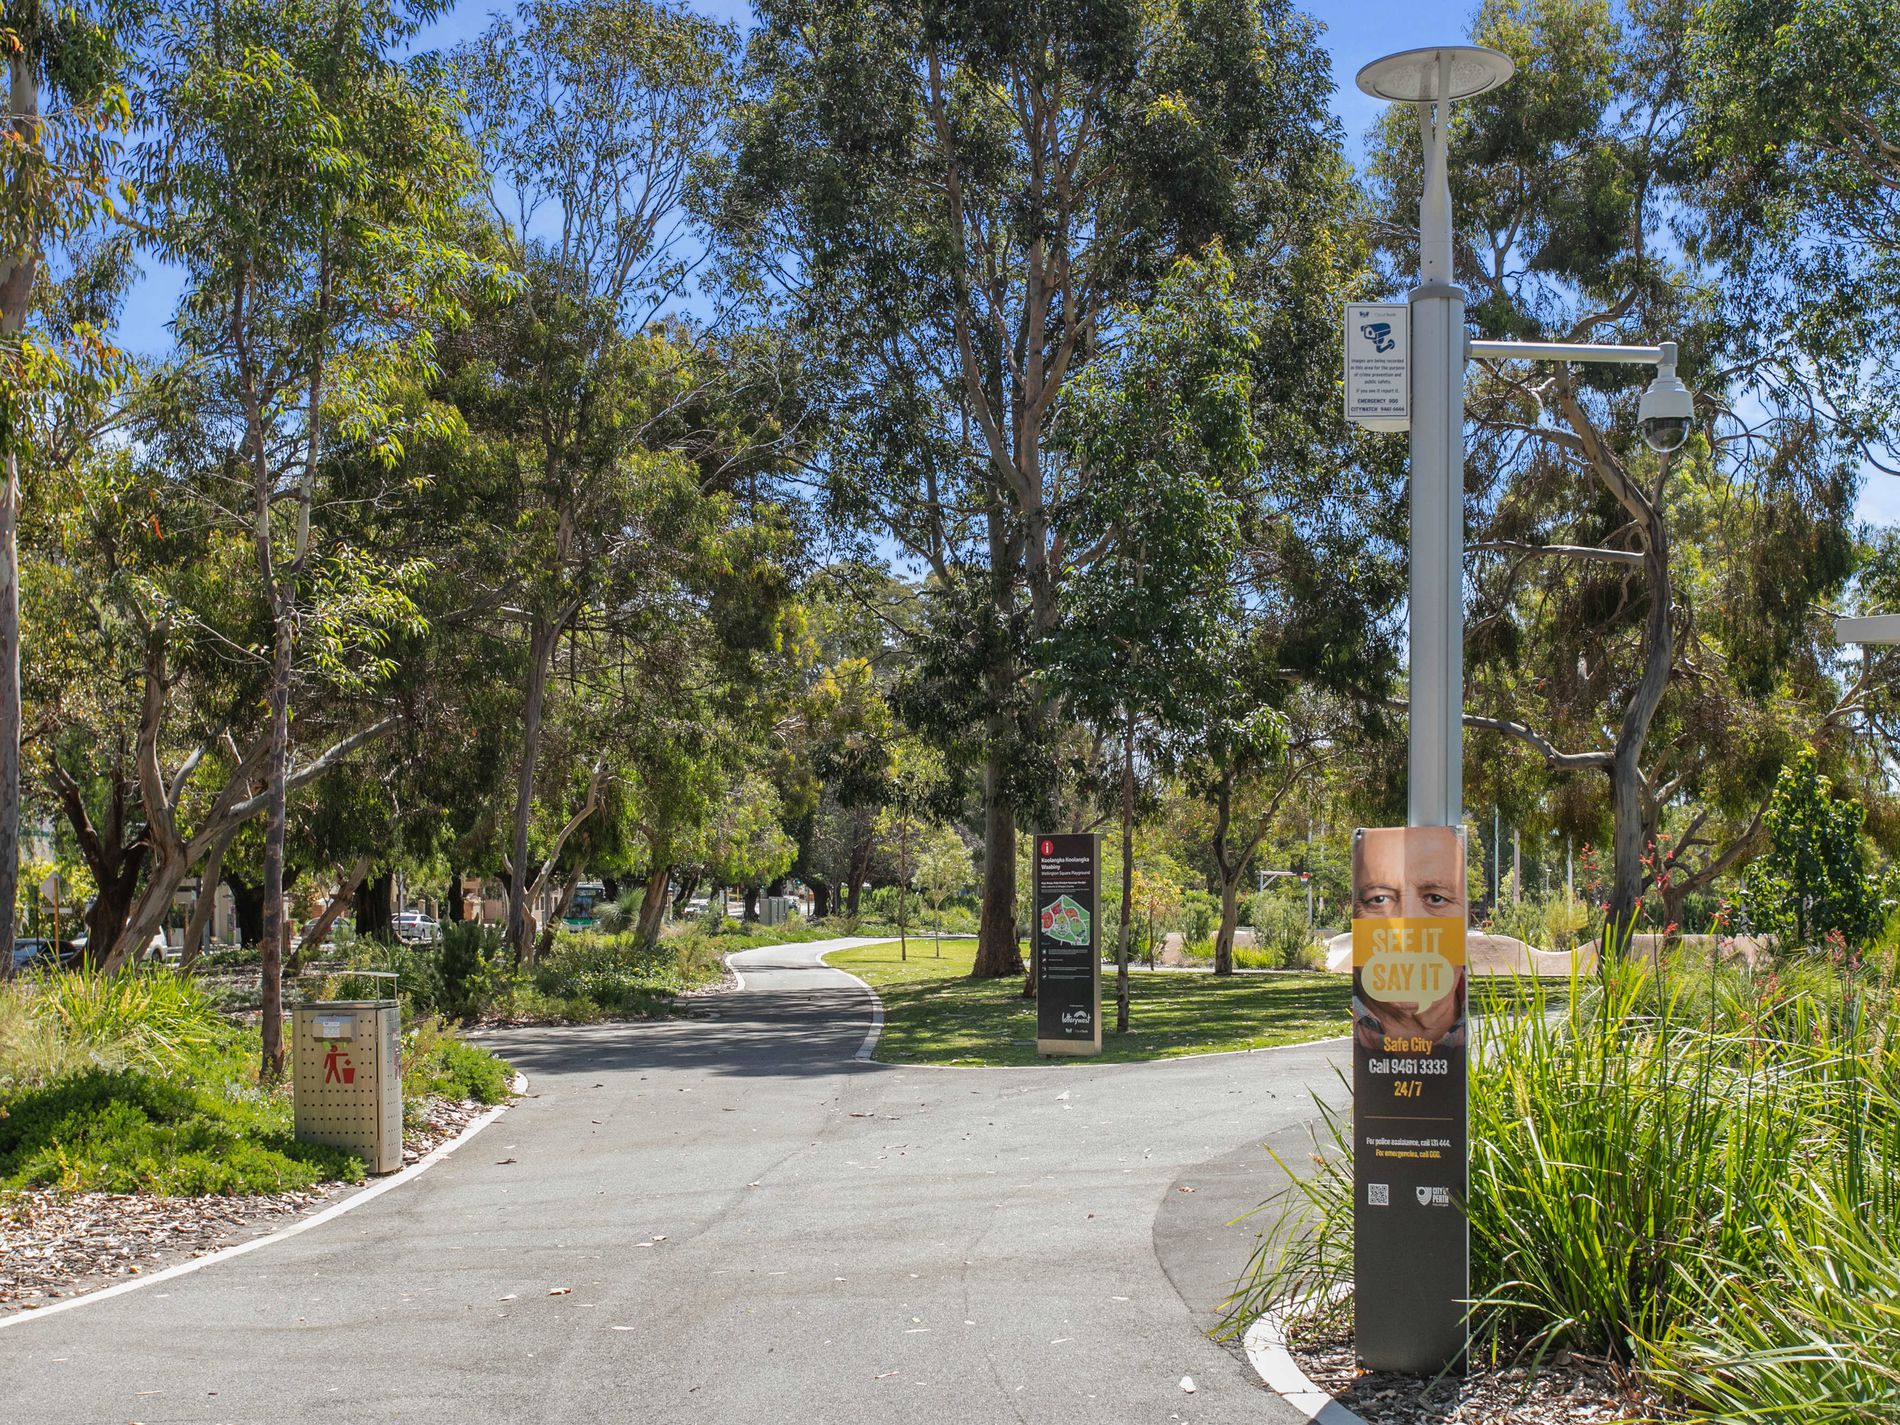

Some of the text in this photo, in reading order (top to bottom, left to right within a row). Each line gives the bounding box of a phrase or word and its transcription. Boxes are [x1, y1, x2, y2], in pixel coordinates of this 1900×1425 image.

[1372, 928, 1445, 953] SEE IT
[1372, 963, 1443, 991] SAY IT
[1384, 1036, 1433, 1055] Safe City
[1368, 1058, 1448, 1074] Call 9461 3333
[1394, 1080, 1422, 1098] 24/7
[1375, 1138, 1390, 1146] police
[1385, 1150, 1419, 1158] emergencies,
